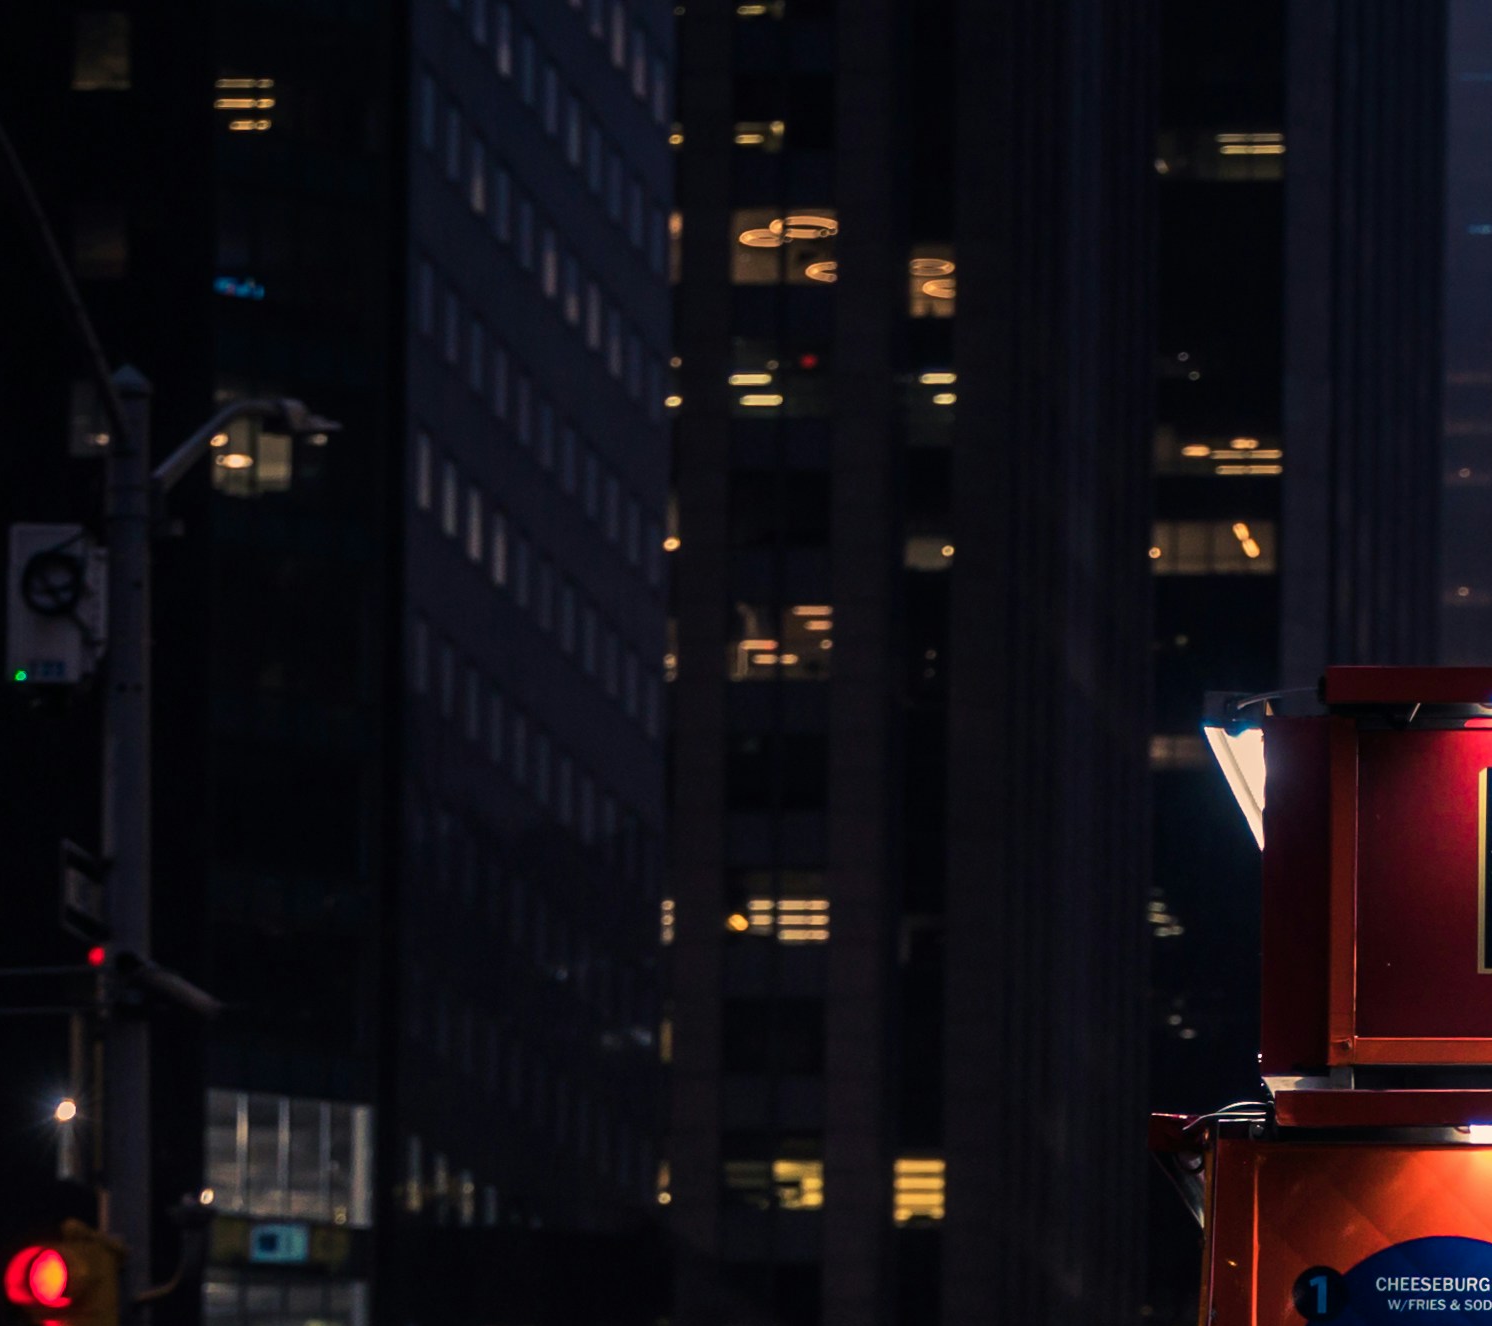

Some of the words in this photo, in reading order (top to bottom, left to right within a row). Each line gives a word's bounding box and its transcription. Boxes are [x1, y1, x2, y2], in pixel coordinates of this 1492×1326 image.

[1308, 1276, 1328, 1314] 1
[1387, 1298, 1445, 1311] W/FRIES
[1448, 1298, 1462, 1311] &
